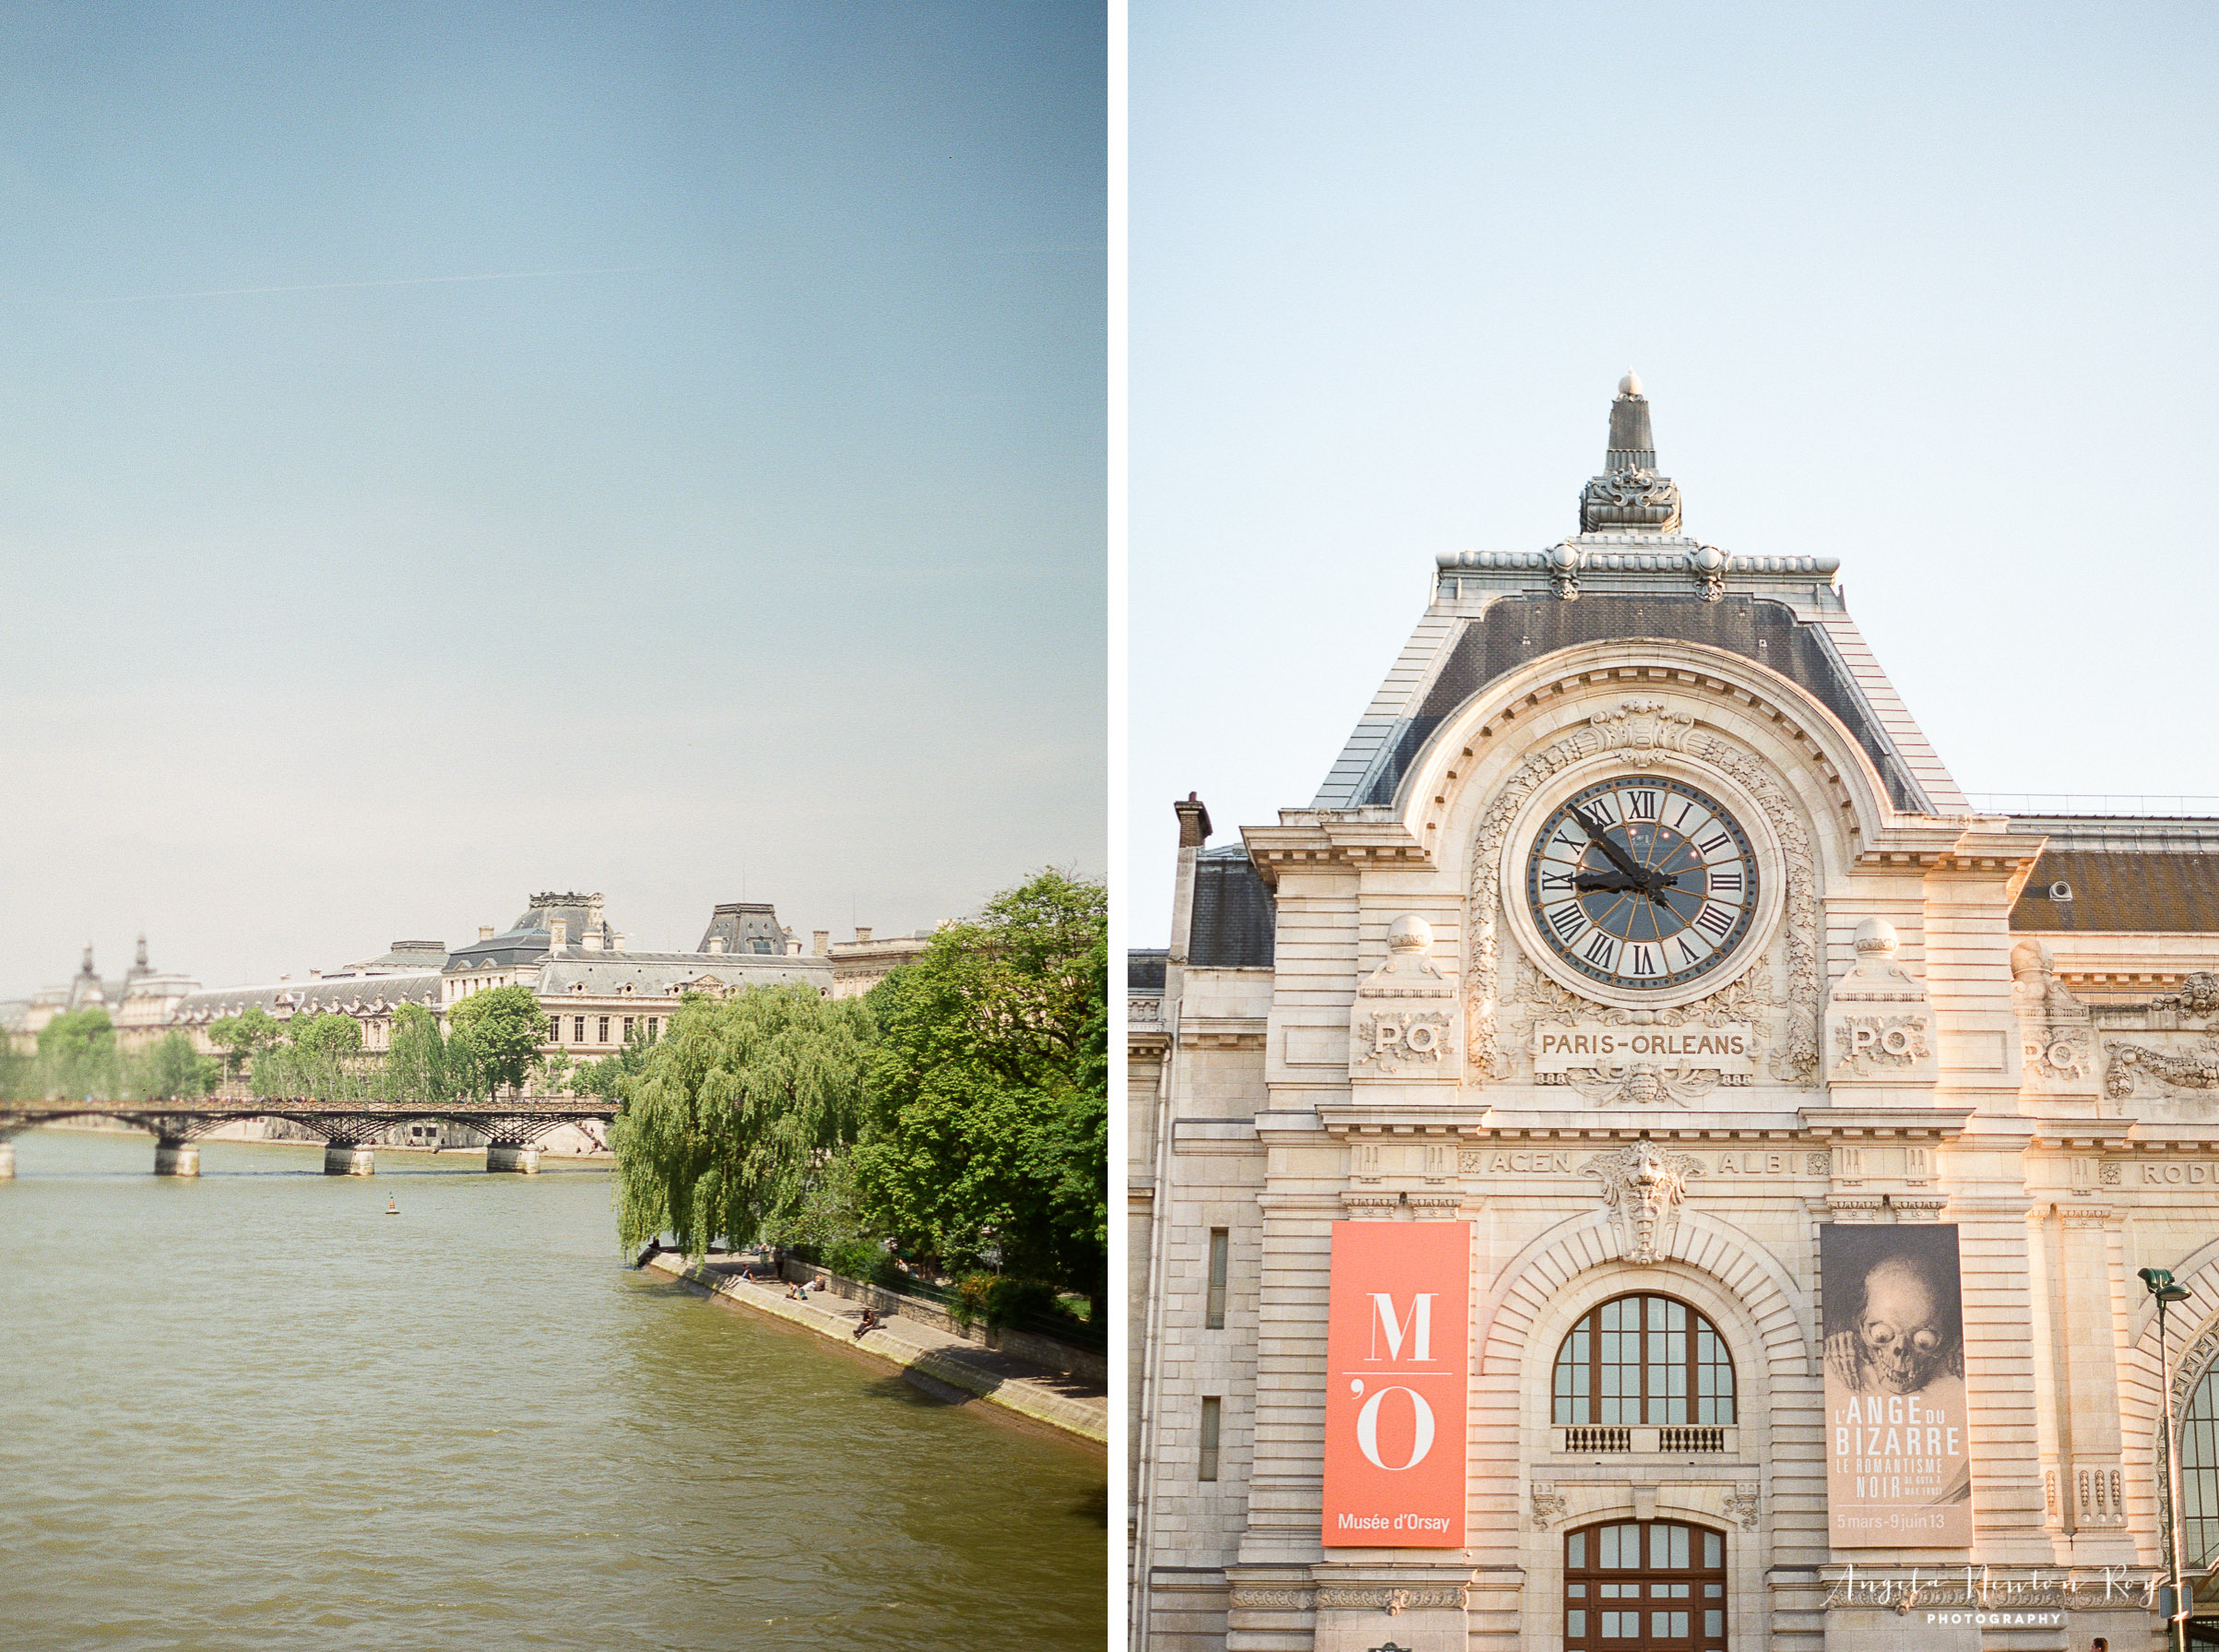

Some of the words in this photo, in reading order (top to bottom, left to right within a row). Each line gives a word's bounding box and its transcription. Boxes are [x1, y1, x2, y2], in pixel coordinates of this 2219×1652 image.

[1583, 799, 1617, 827] XI
[1627, 790, 1655, 819] XII
[1553, 829, 1586, 855] X
[1698, 832, 1731, 855] II
[1542, 871, 1573, 891] IX
[1711, 873, 1742, 892] III
[1549, 902, 1587, 943] VIII
[1584, 931, 1615, 969] VII
[1632, 945, 1656, 975] VI
[1677, 936, 1701, 965] V
[1542, 1034, 1745, 1055] PARIS-ORLEANS
[1489, 1151, 1572, 1172] AGEN
[1718, 1152, 1797, 1173] ALBI
[1363, 1292, 1440, 1362] M
[1926, 1408, 1945, 1425] DU
[1835, 1427, 1960, 1456] BIZARRE
[1836, 1457, 1849, 1473] LE
[1856, 1457, 1942, 1474] ROMANTISME
[1856, 1476, 1901, 1499] NOIR
[1338, 1513, 1389, 1530] Musée
[1394, 1513, 1450, 1533] d'Orsay
[1837, 1514, 1845, 1528] 5
[1901, 1514, 1927, 1531] juin
[1929, 1514, 1945, 1528] 13
